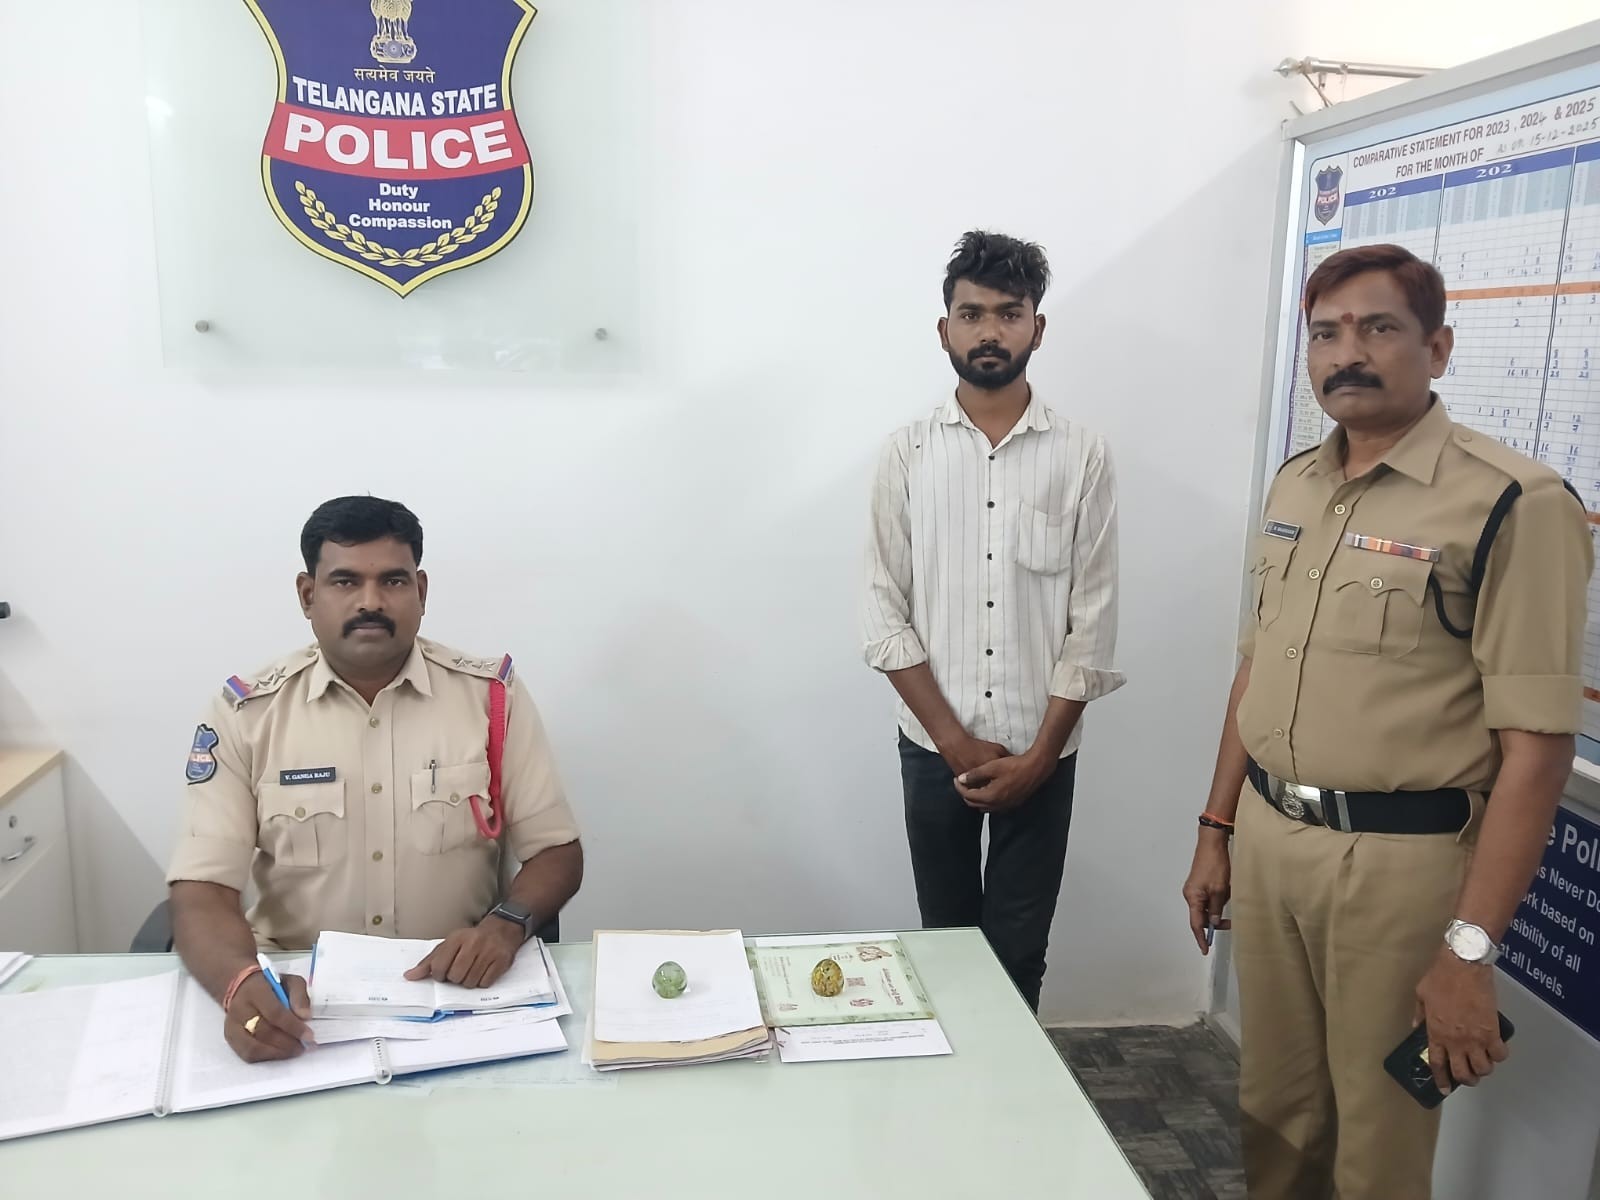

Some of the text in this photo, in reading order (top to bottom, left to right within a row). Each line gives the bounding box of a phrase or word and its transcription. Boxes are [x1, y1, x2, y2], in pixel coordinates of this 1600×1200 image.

[354, 65, 435, 83] सत्यमेव जयते
[292, 75, 497, 116] TELANGANA STATE
[284, 112, 513, 169] POLICE
[1353, 144, 1408, 168] COMPARATIVE
[1409, 131, 1462, 155] STATEMENT
[1463, 125, 1484, 142] FOR
[1486, 119, 1510, 137] 2023
[1554, 106, 1562, 121] &
[1565, 97, 1596, 118] 2025
[1395, 147, 1485, 178] FOR THE MONTH OF
[368, 198, 430, 212] Honour
[379, 183, 418, 199] Duty
[348, 213, 452, 230] Compassion
[1549, 867, 1585, 901] Never
[1540, 897, 1577, 934] based
[1578, 926, 1595, 946] on
[1511, 951, 1525, 969] all
[1526, 958, 1566, 999] Levels.
[1551, 945, 1565, 960] of
[1565, 954, 1581, 973] all
